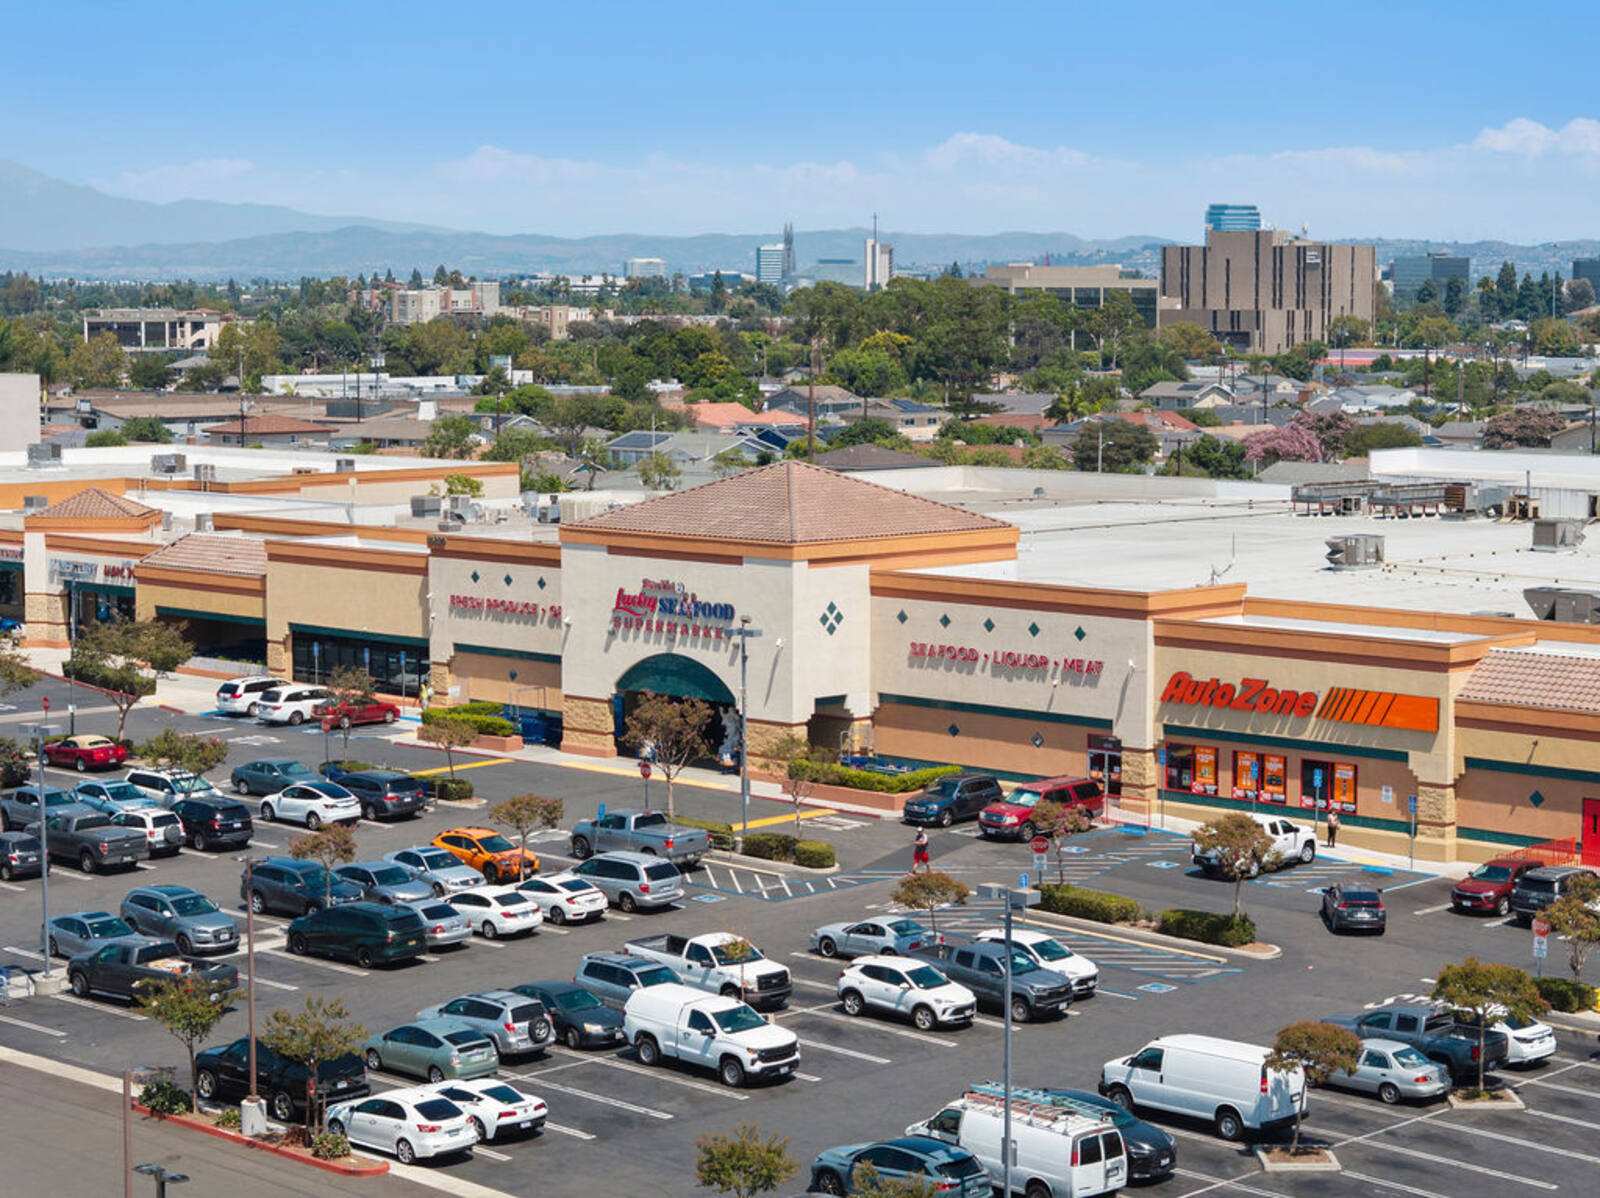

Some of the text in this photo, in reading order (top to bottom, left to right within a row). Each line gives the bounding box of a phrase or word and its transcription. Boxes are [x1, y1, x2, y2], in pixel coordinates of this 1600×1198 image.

[449, 594, 485, 609] FRESH
[485, 598, 538, 616] PRODUCE
[613, 587, 736, 621] Lucky SEAFOOD
[909, 641, 1104, 675] SEAFOOD LIQUOR MEAT
[1160, 670, 1319, 718] AutoZone
